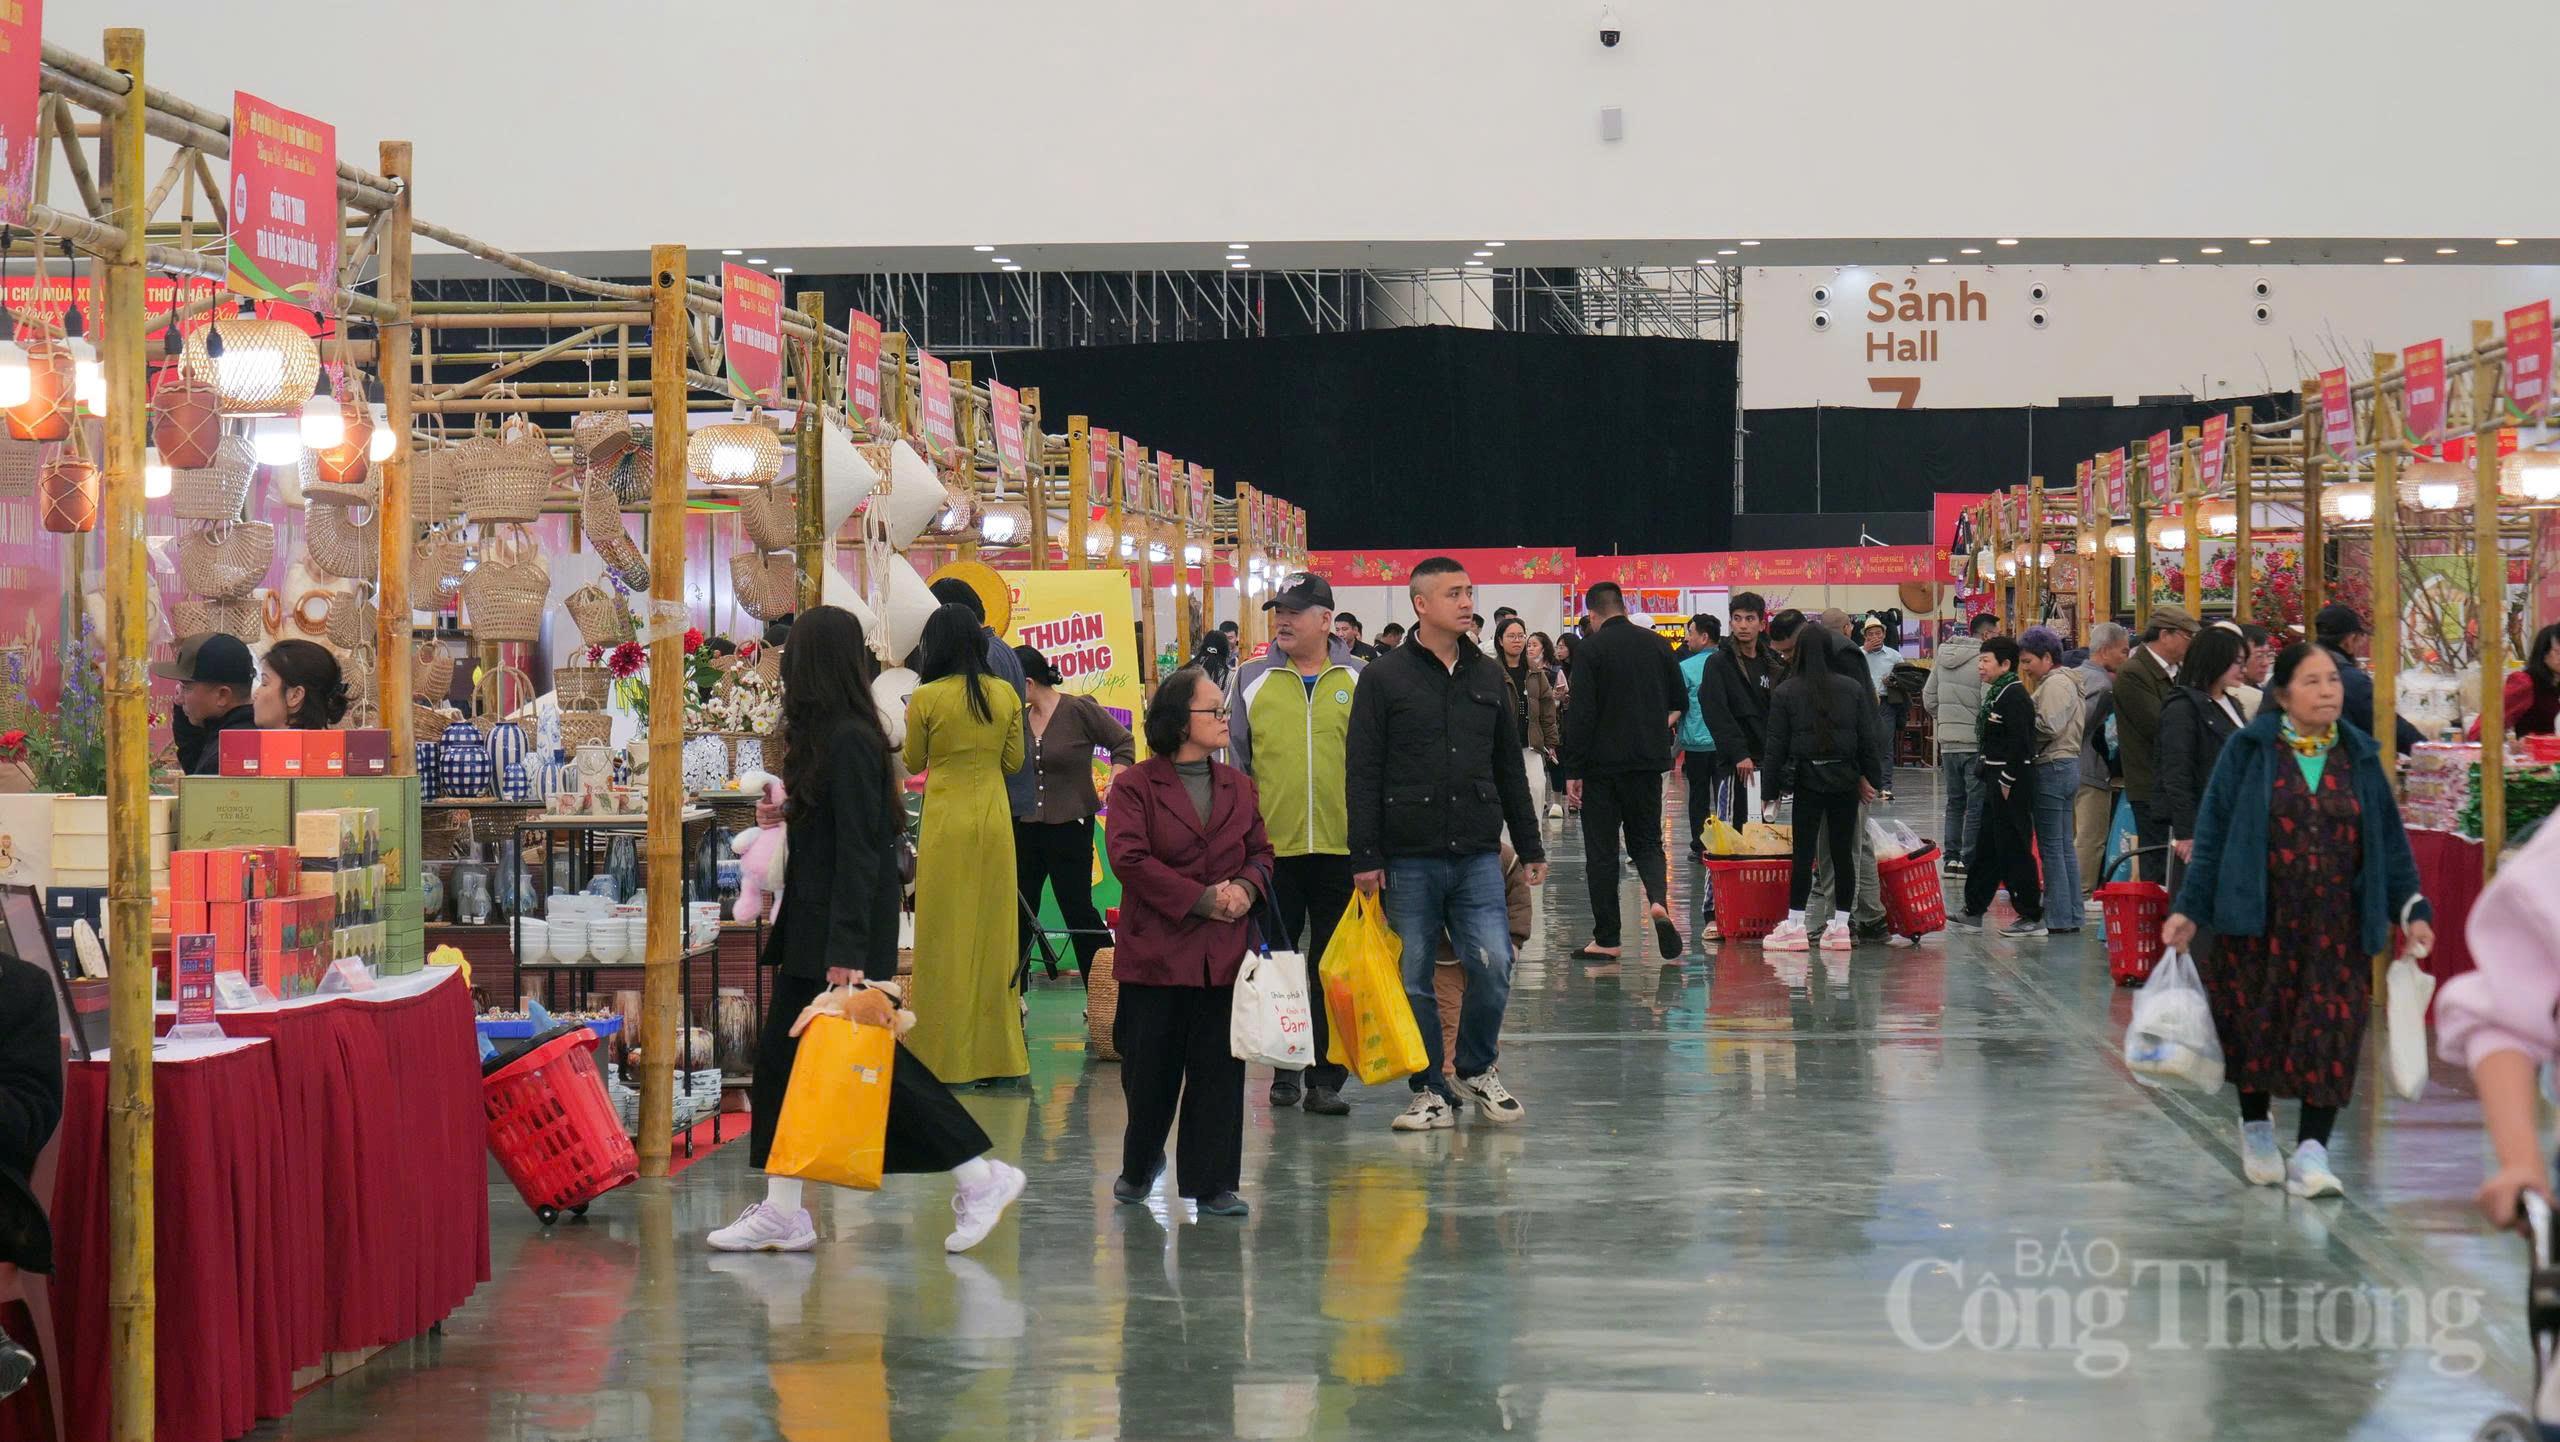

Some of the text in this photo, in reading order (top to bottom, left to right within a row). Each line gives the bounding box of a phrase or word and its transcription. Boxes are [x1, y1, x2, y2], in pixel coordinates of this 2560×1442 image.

[1867, 278, 1987, 323] Sảnh
[1867, 330, 1937, 361] Hall
[1082, 667, 1129, 697] Chips
